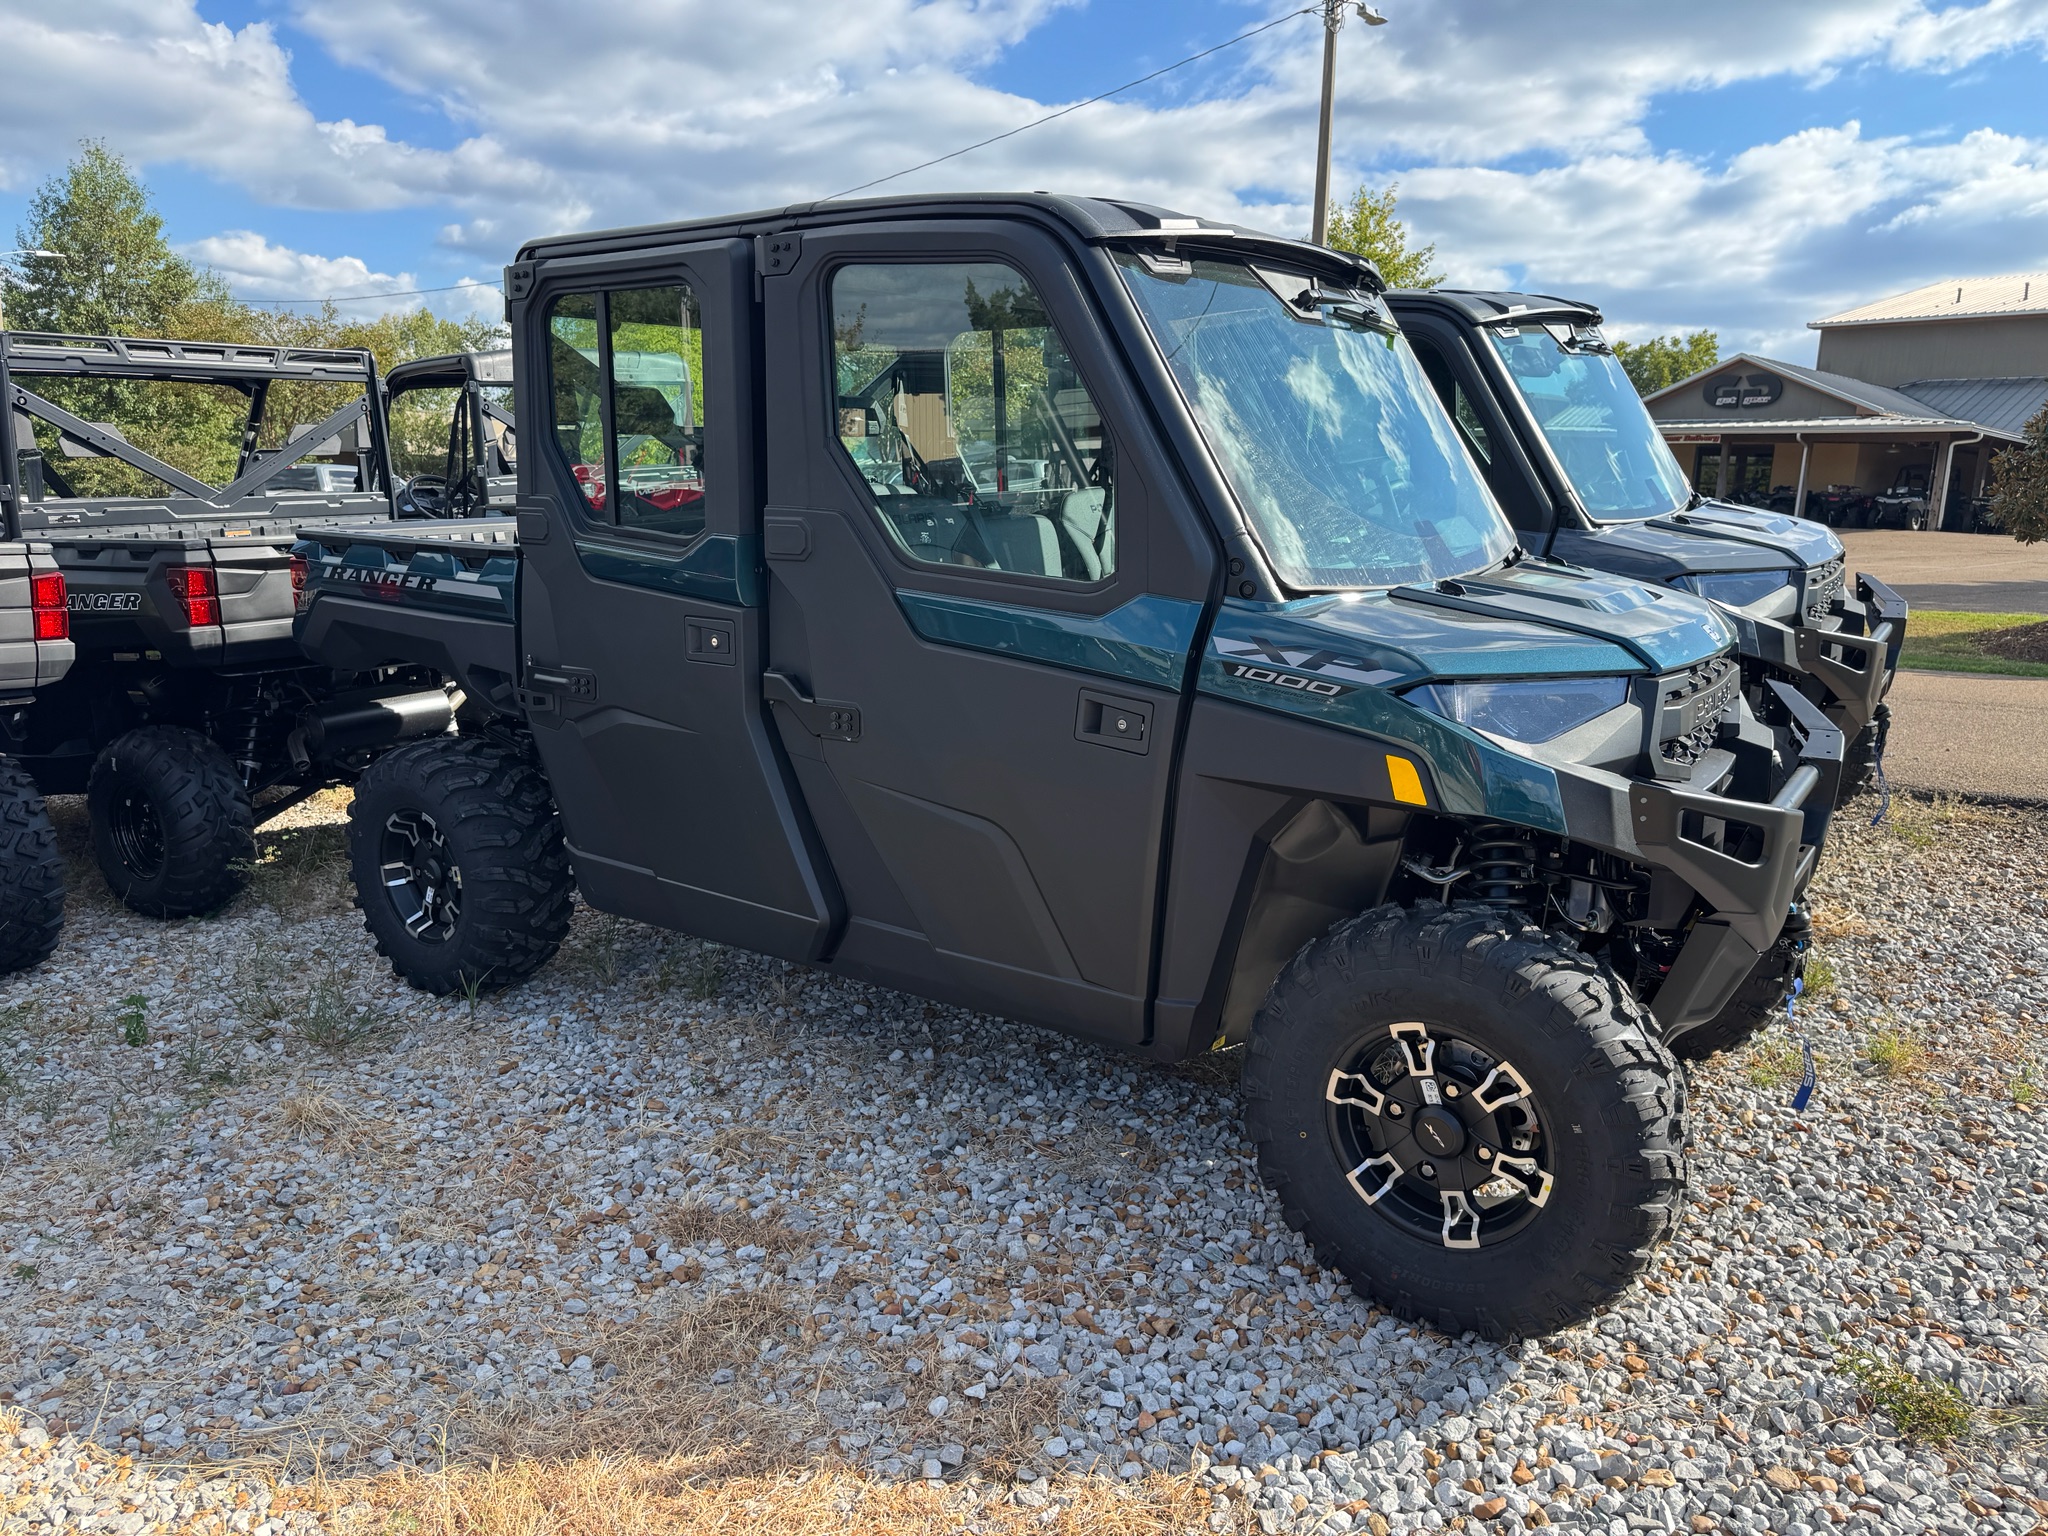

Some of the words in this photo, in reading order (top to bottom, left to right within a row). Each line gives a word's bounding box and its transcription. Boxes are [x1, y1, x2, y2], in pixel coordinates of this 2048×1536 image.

[329, 565, 437, 591] RANGER
[66, 592, 141, 611] ANGER
[1223, 635, 1384, 672] XP
[1233, 665, 1342, 696] 1000
[1803, 1041, 1814, 1088] LARIS
